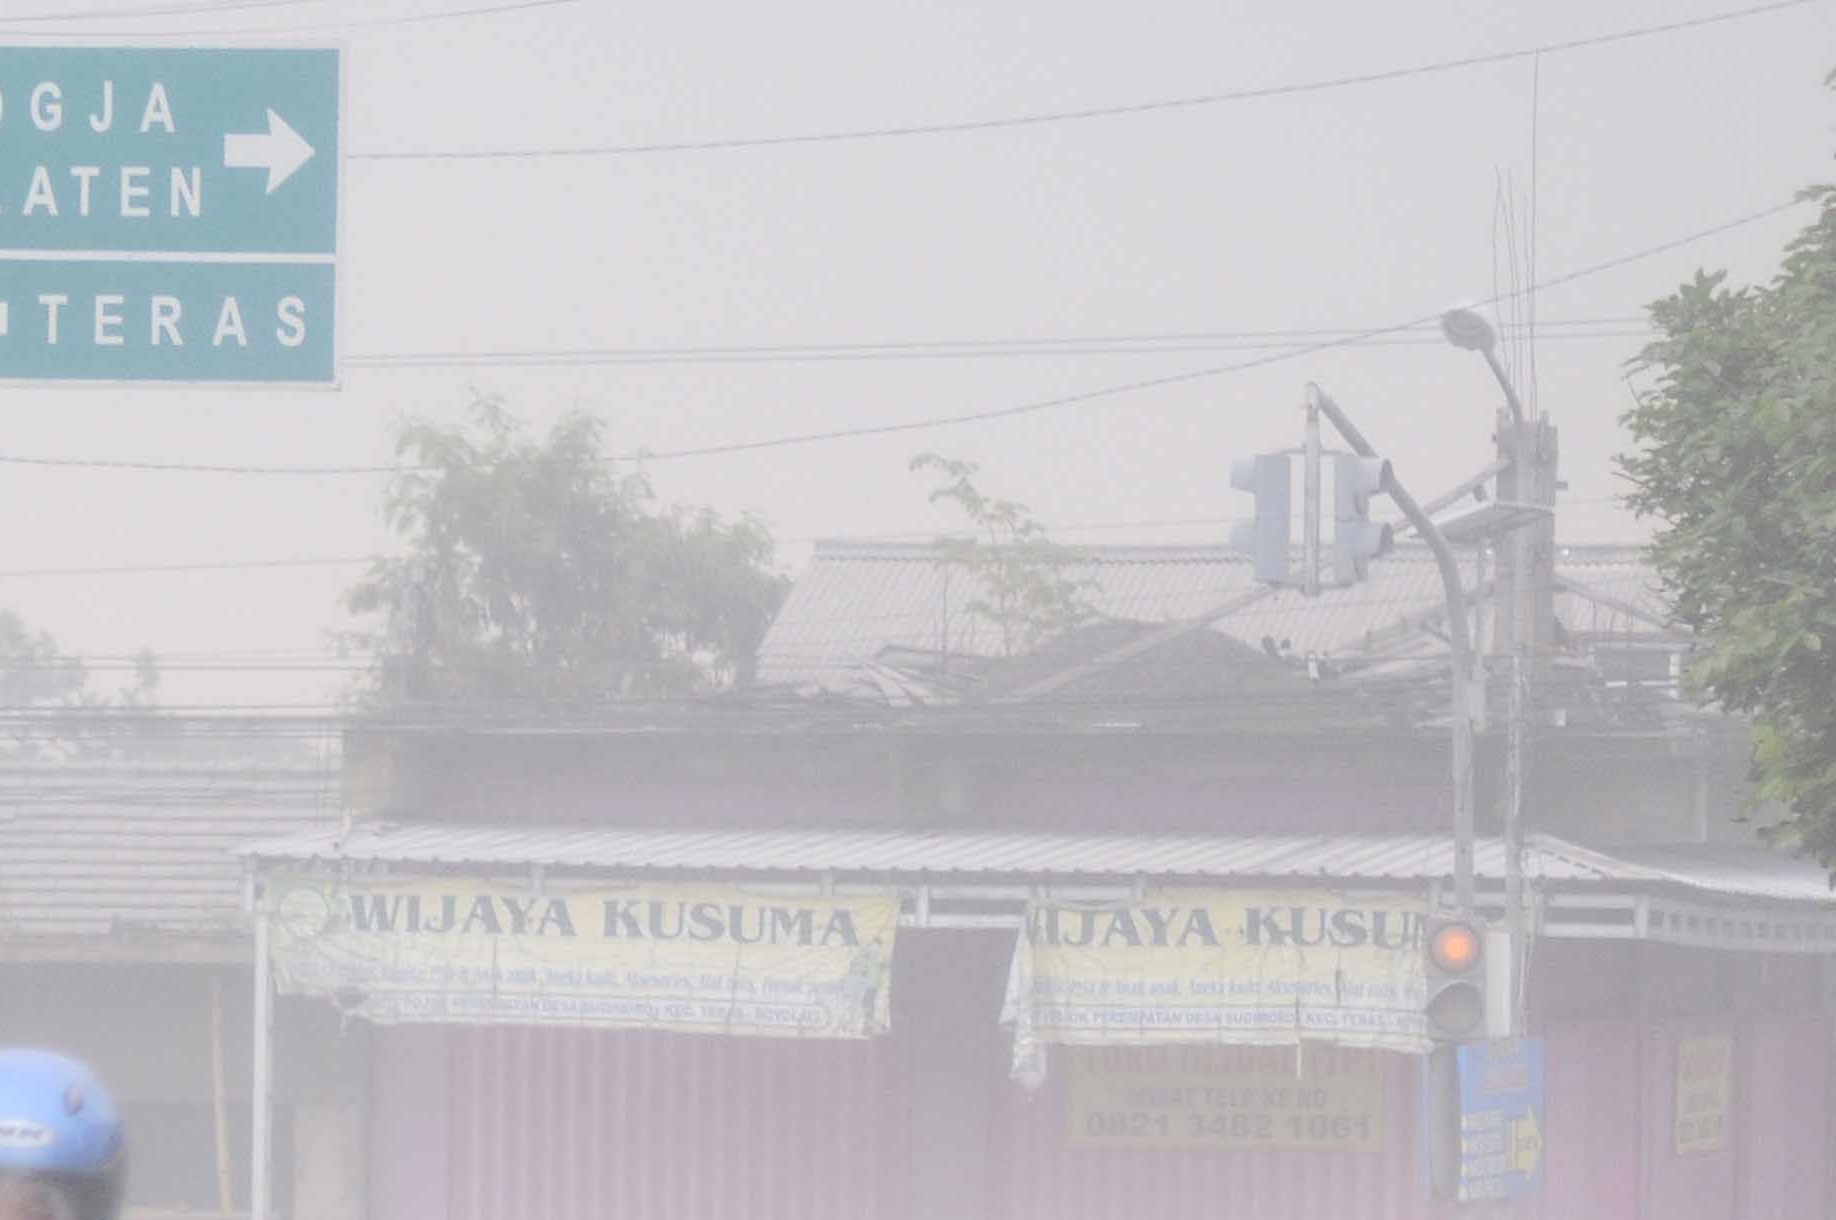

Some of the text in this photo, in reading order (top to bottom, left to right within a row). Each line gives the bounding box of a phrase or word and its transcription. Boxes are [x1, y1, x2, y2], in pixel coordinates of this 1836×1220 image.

[39, 293, 307, 348] TERAS
[348, 894, 861, 947] WIJAYA KUSUMA
[1086, 1112, 1169, 1138] 0821
